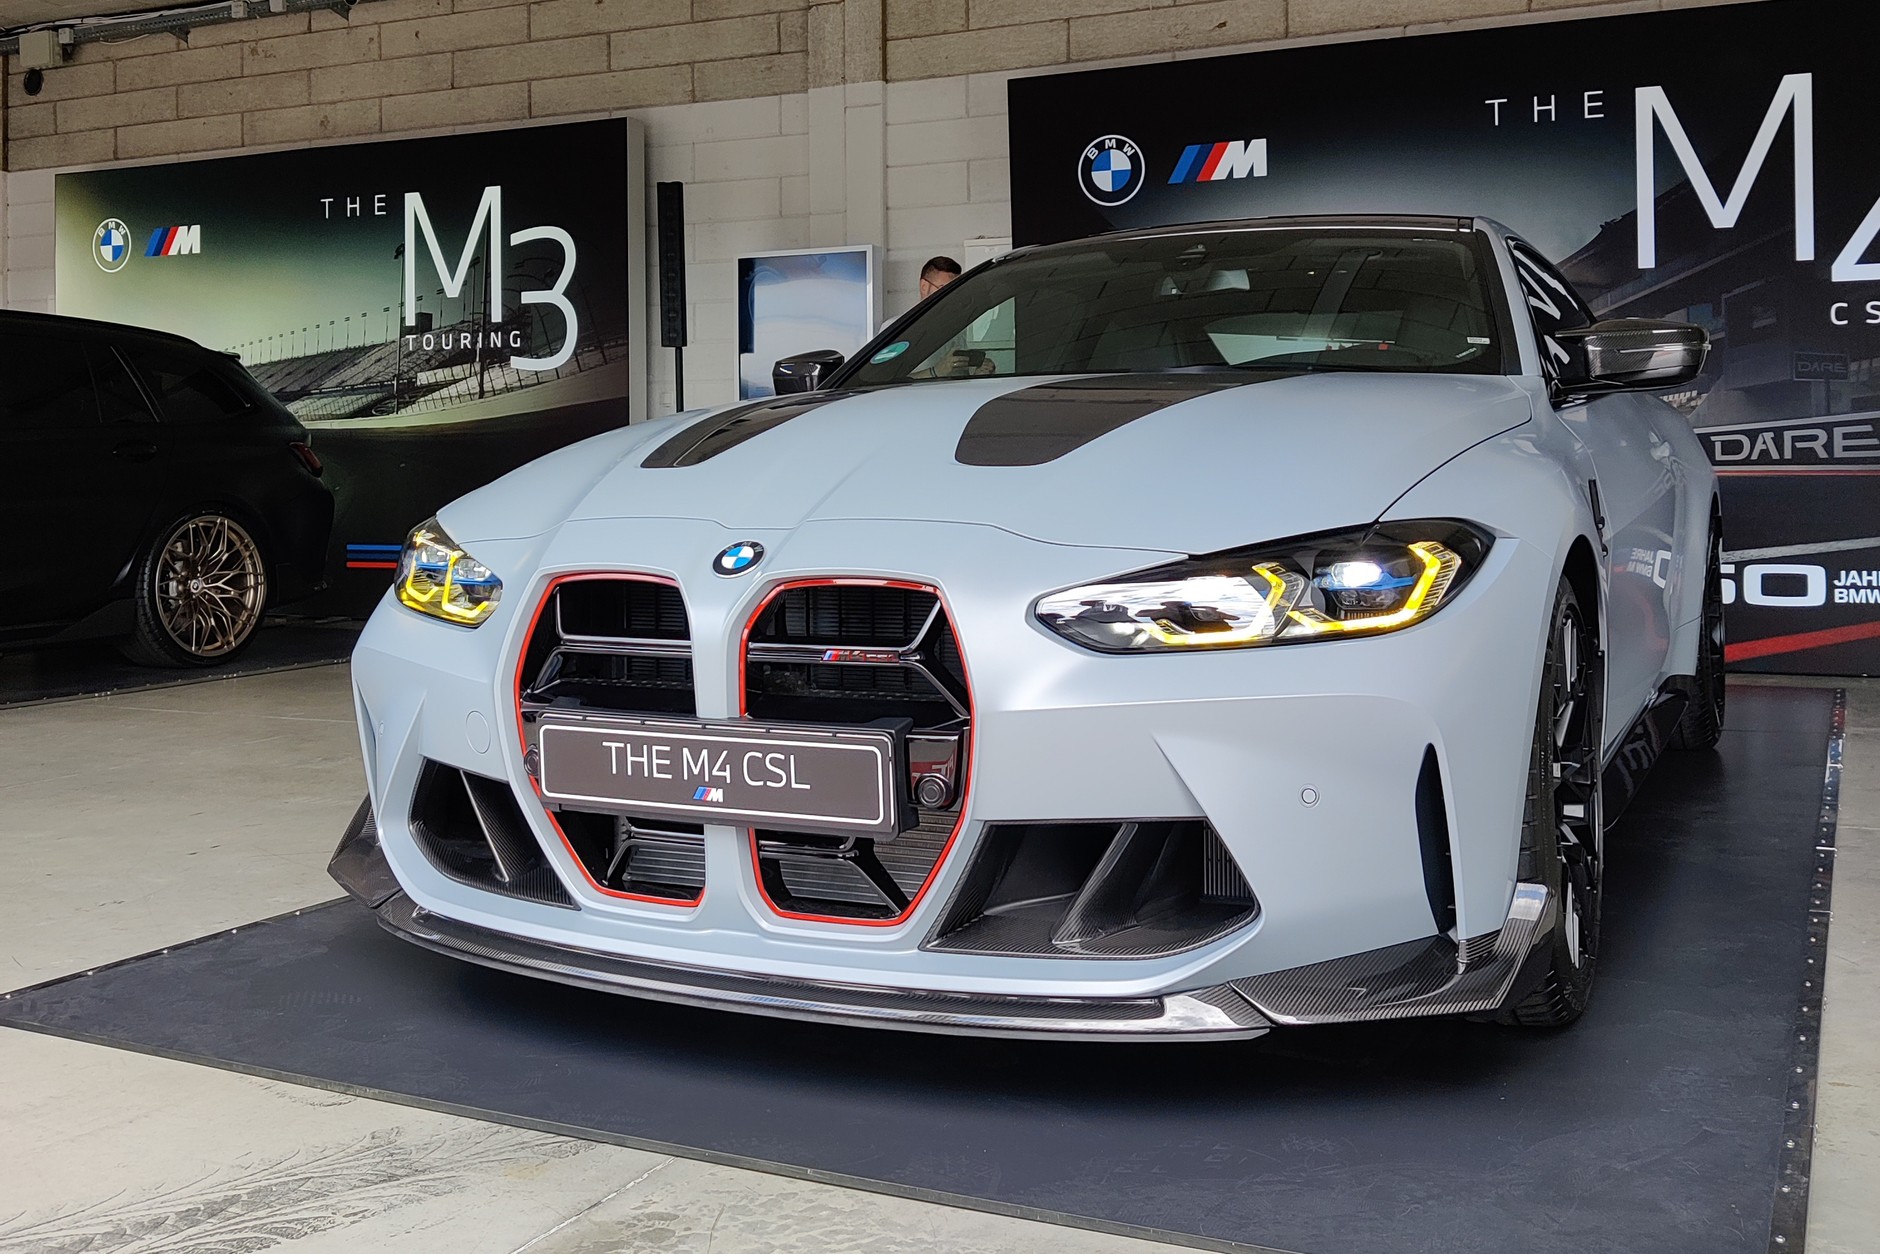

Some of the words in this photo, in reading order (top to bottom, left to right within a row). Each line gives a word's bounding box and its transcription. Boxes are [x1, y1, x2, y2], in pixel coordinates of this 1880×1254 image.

[1485, 90, 1604, 126] THE
[1087, 139, 1135, 160] BMW
[1210, 138, 1267, 180] M
[98, 221, 126, 237] BMW
[167, 224, 201, 256] M
[320, 194, 387, 219] THE
[404, 185, 578, 371] M3
[405, 330, 521, 351] TOURING
[1799, 360, 1848, 373] DARE
[1709, 424, 1880, 461] DARE
[602, 741, 673, 780] THE
[682, 747, 731, 784] M4
[742, 751, 811, 790] CSL
